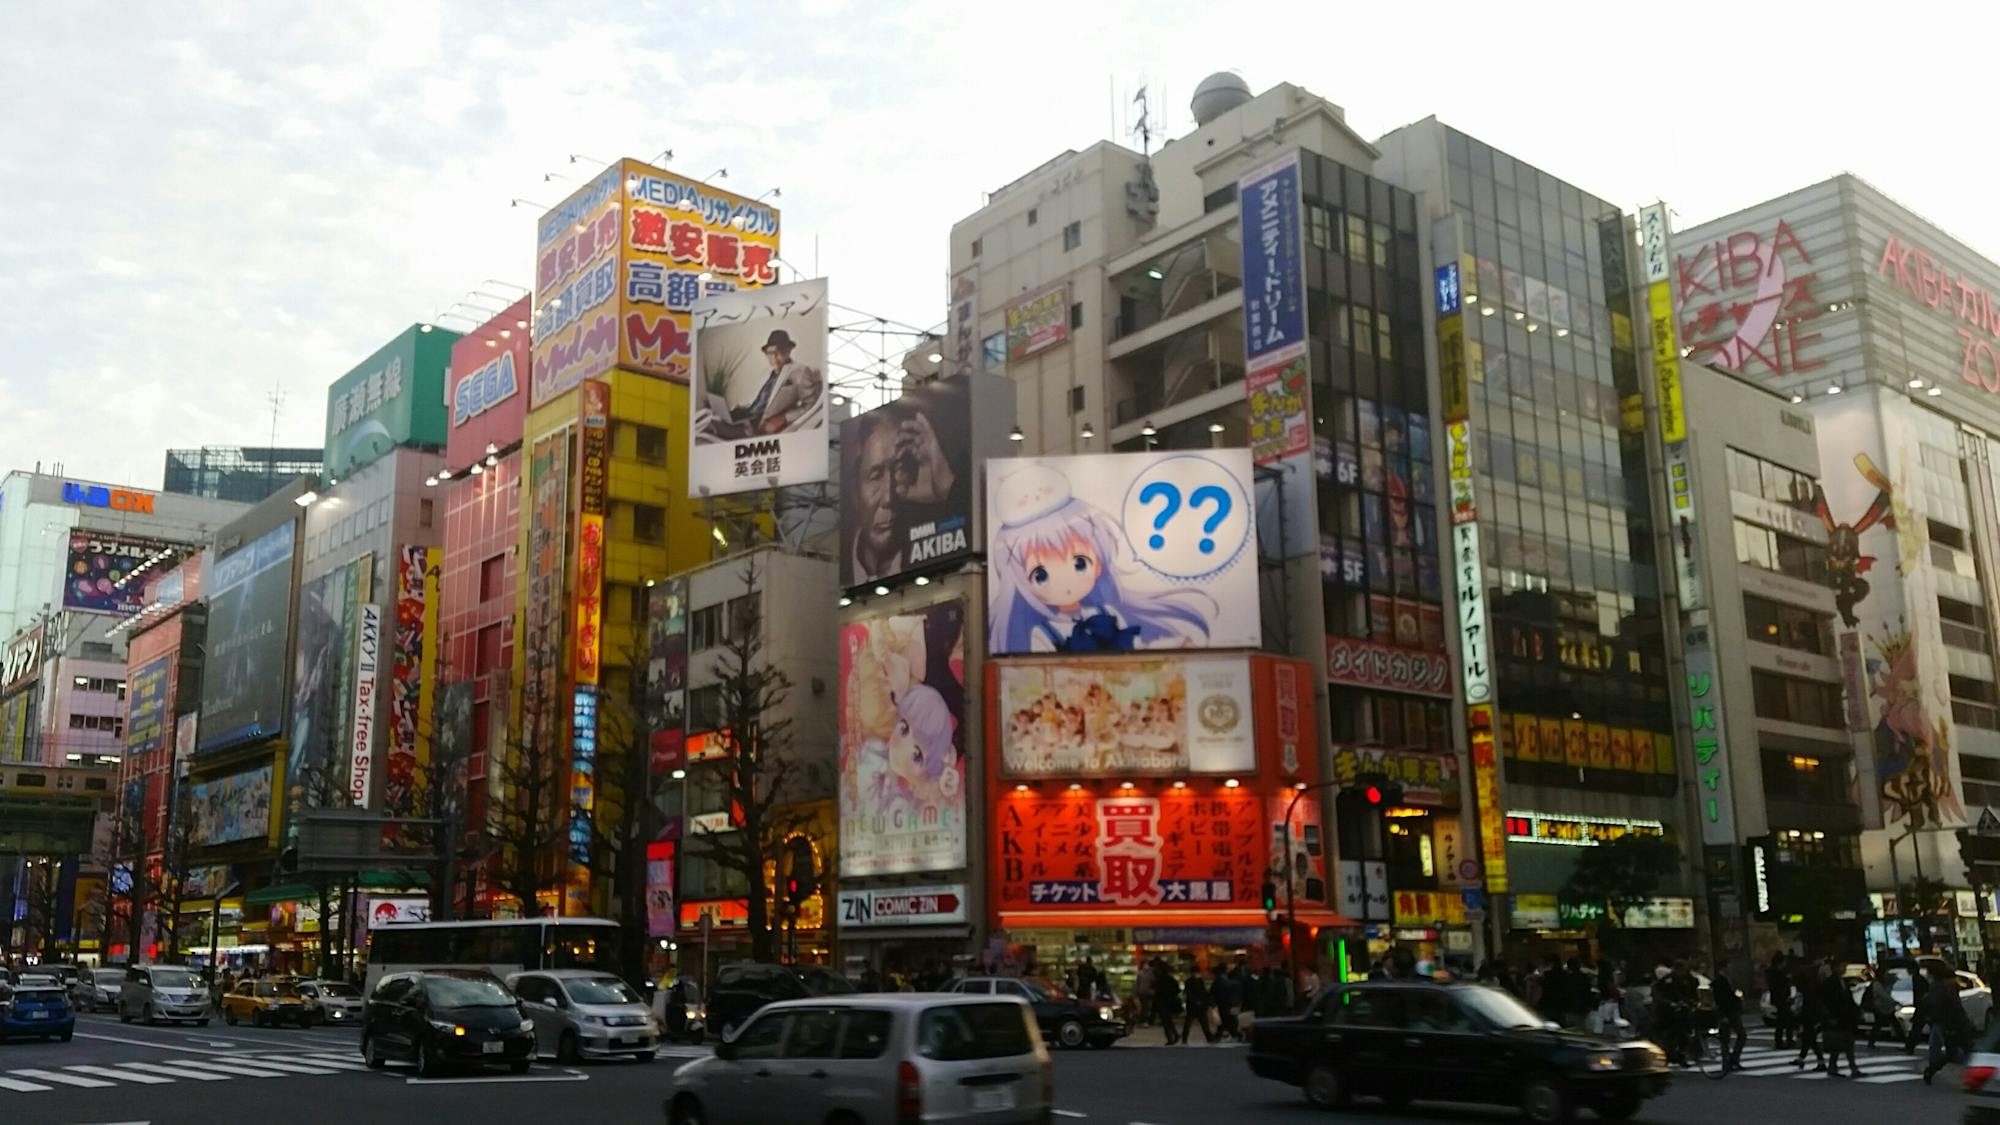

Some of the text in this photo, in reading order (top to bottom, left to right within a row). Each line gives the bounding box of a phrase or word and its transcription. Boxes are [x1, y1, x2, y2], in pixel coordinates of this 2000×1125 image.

[631, 174, 778, 234] MEDIAリサイクル
[630, 207, 774, 282] 激安販売
[454, 350, 519, 427] SEGA
[734, 440, 780, 460] DMM
[734, 458, 781, 478] 英会話
[1337, 461, 1358, 485] 6F
[910, 529, 967, 564] AKIBA
[1343, 559, 1364, 583] 5F
[362, 608, 377, 661] AKKY
[351, 755, 370, 800] Shop
[1009, 754, 1080, 771] Welcome
[1084, 753, 1099, 770] to
[1101, 803, 1157, 900] 買取
[842, 893, 939, 922] ZIN COMIC ZIN
[1032, 883, 1096, 902] チケット
